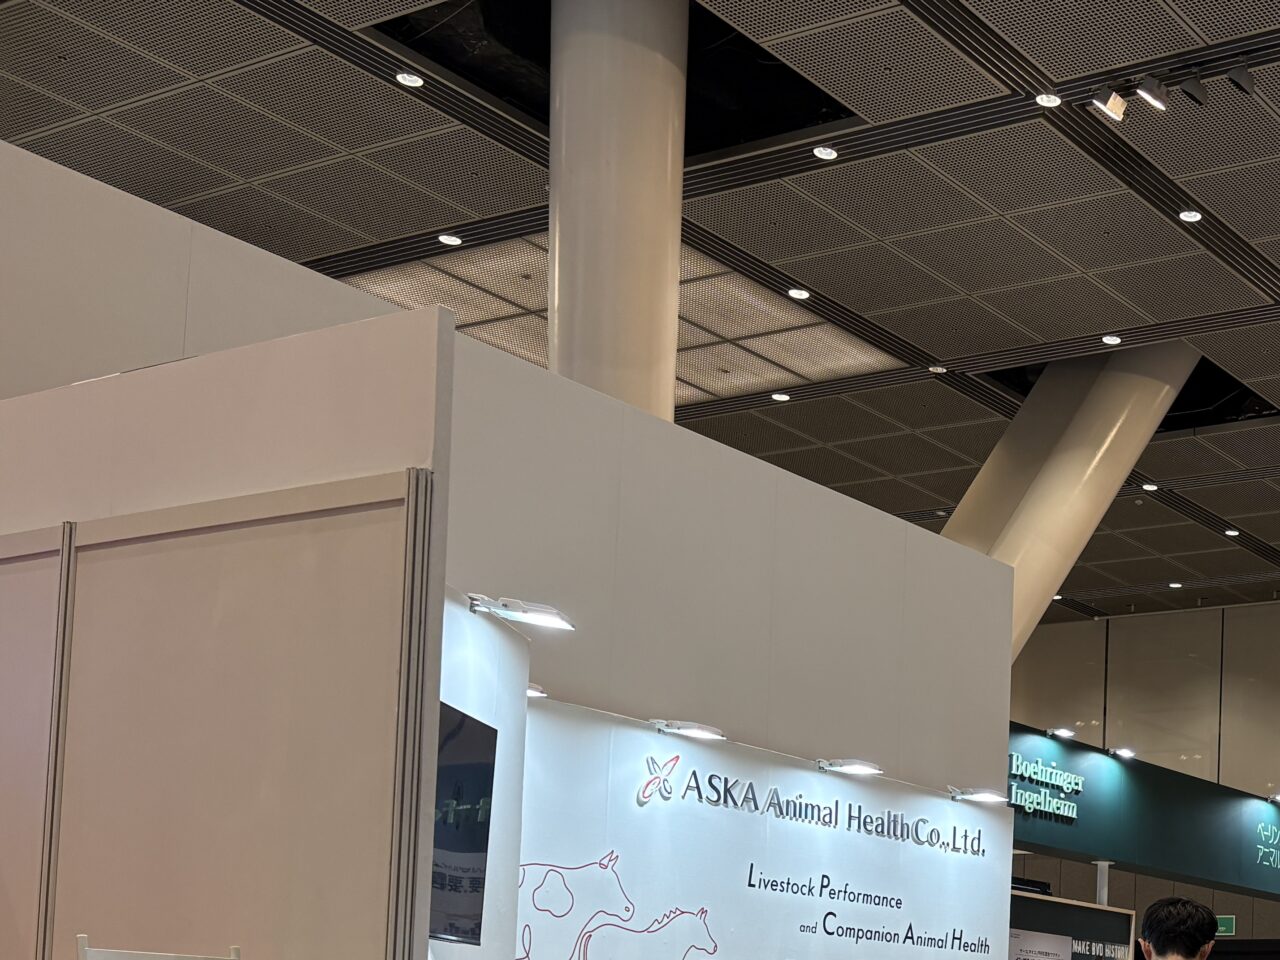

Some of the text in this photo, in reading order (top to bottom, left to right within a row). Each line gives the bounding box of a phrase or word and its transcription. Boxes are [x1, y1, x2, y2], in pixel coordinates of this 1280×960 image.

[1009, 752, 1085, 793] Boehringer
[682, 770, 760, 813] ASKA
[761, 787, 839, 829] Animal
[847, 803, 911, 843] Health
[1010, 782, 1078, 819] Ingelheim
[747, 863, 903, 909] Livestock Performance
[799, 911, 991, 954] and Companion Animal Health
[1072, 940, 1090, 956] MAKE
[1091, 943, 1104, 957] BVD
[1105, 945, 1129, 960] HISTORY
